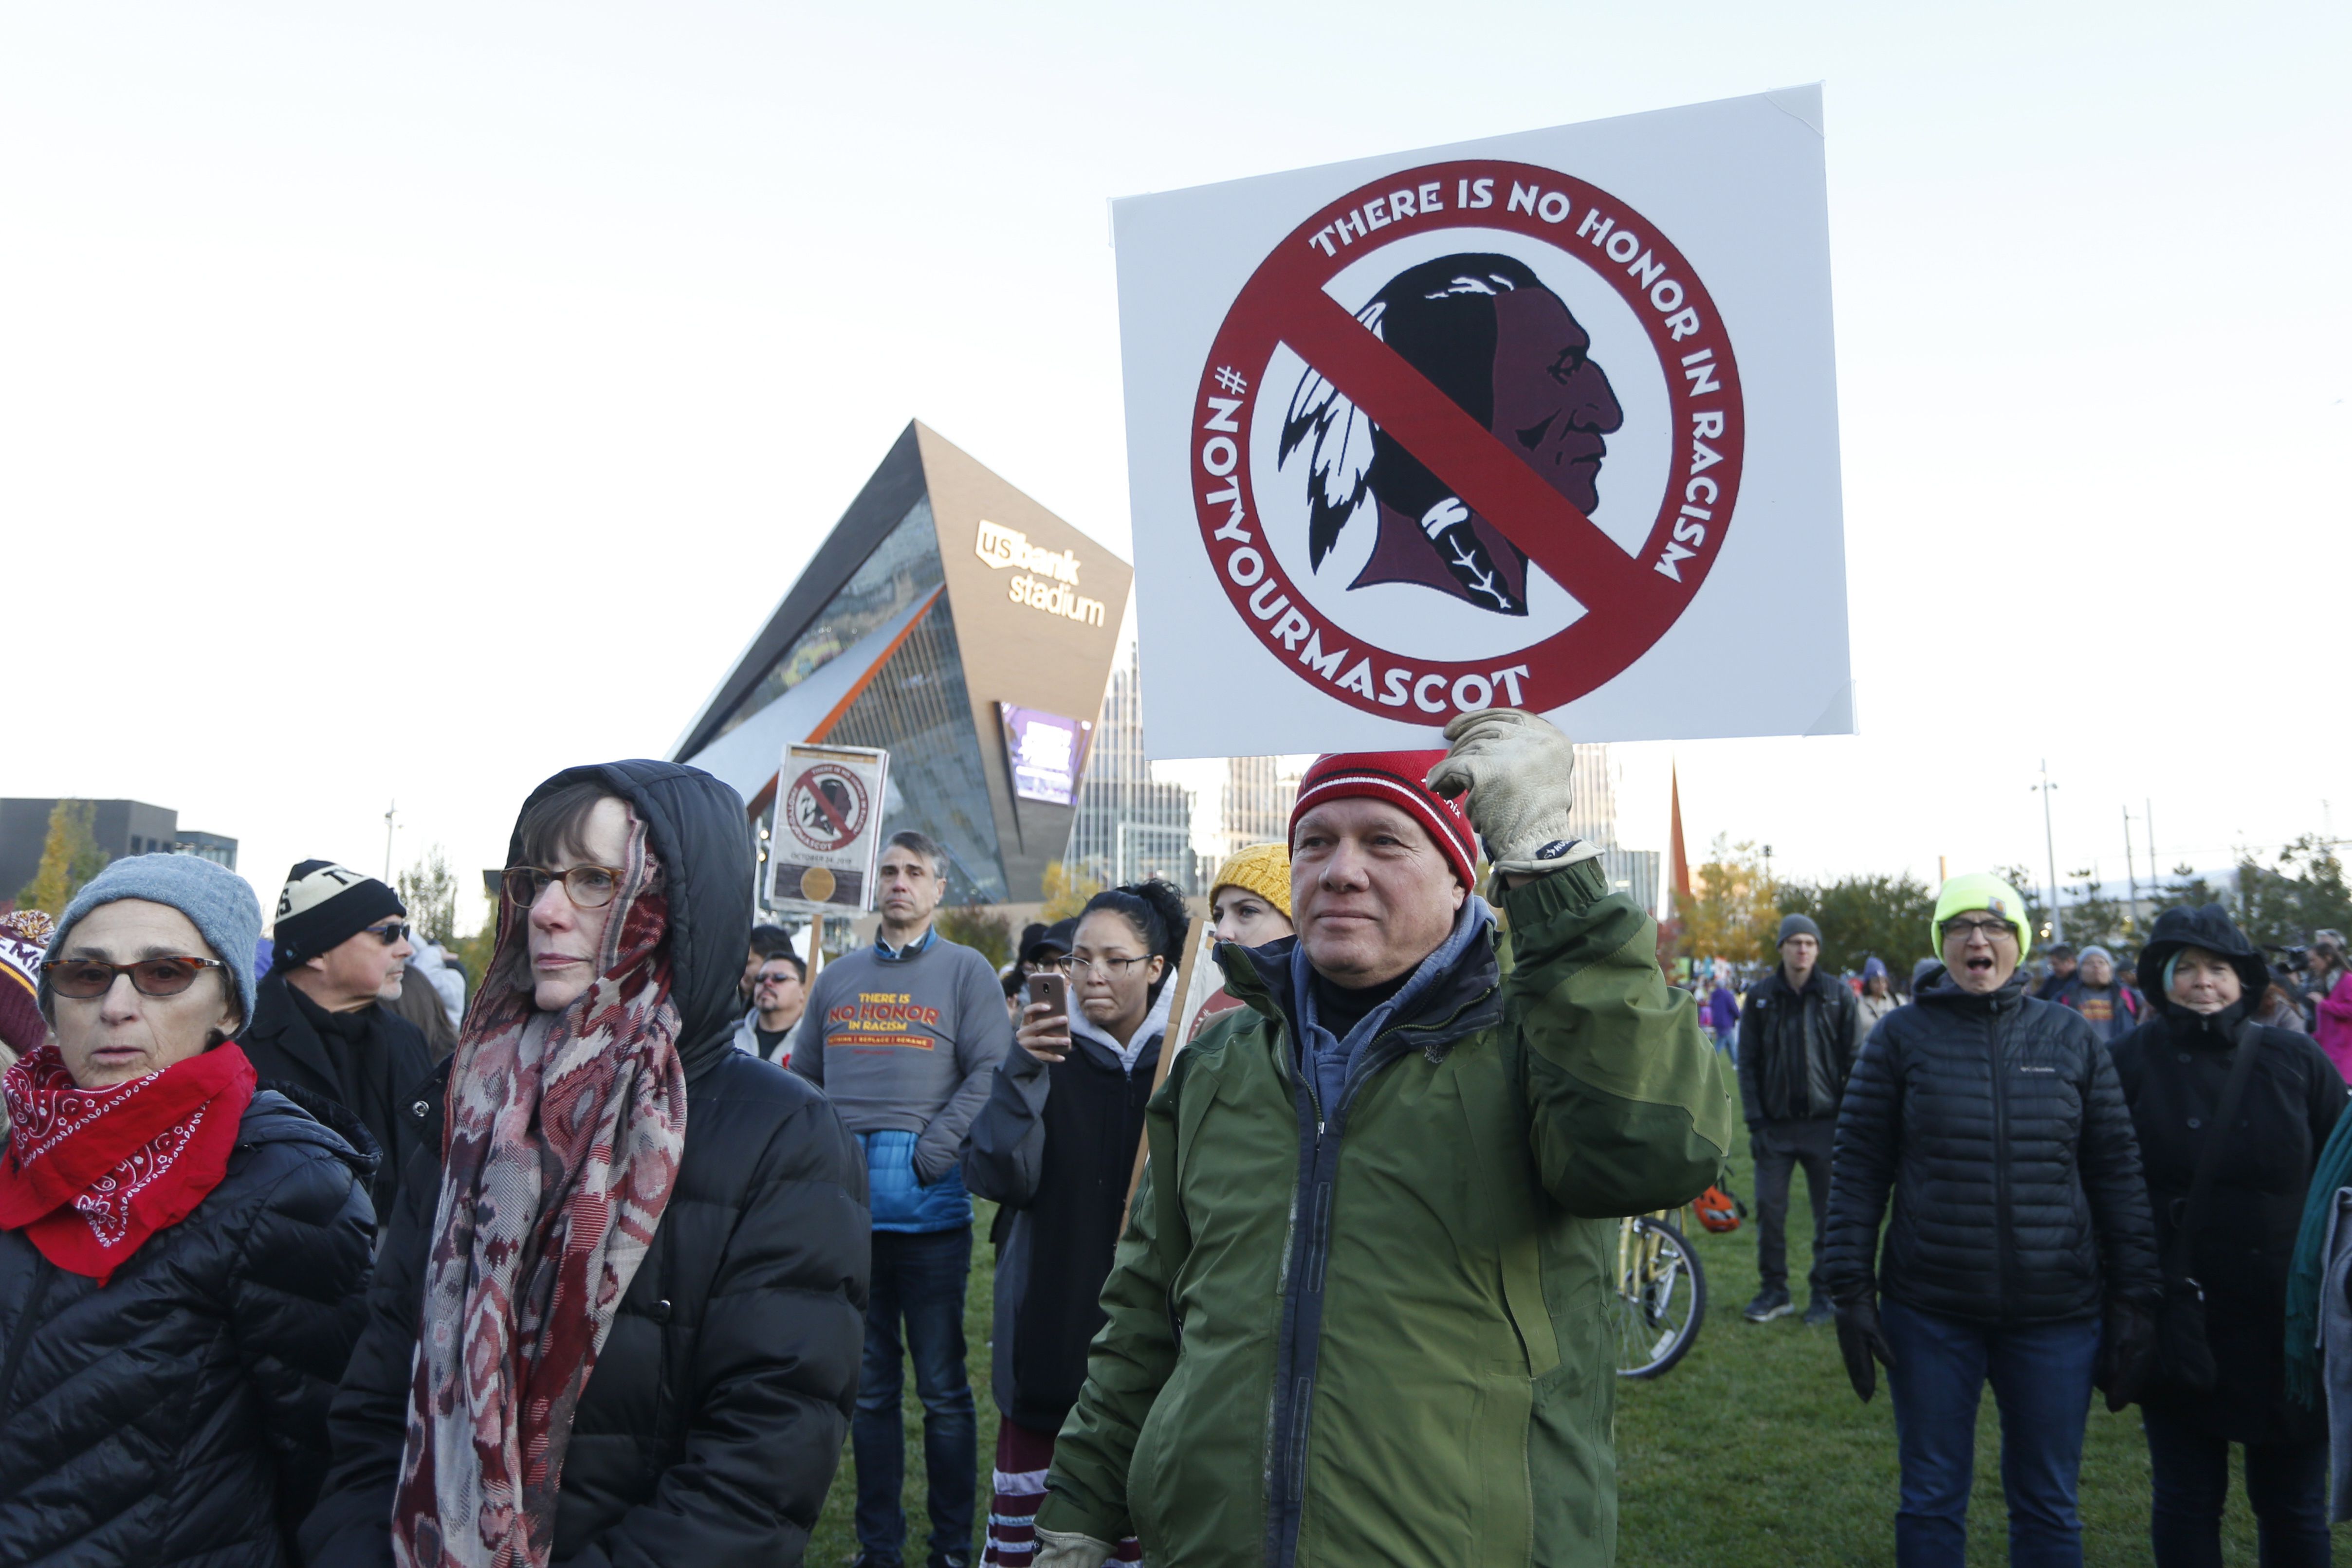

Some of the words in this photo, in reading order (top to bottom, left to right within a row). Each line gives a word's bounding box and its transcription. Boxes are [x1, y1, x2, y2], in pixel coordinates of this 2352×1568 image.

[1458, 179, 1494, 208] IS
[1507, 181, 1570, 223] NO
[1308, 182, 1443, 257] THERE
[1576, 208, 1699, 342] HONOR
[1682, 348, 1720, 397] IN
[1654, 411, 1724, 583] RACISM
[1010, 574, 1105, 627] stadium
[829, 1006, 856, 1023] NO
[860, 1004, 939, 1025] HONOR
[860, 993, 897, 1003] THERE
[900, 994, 910, 1004] IS
[849, 1021, 860, 1030] IN
[863, 1021, 907, 1031] RACISM
